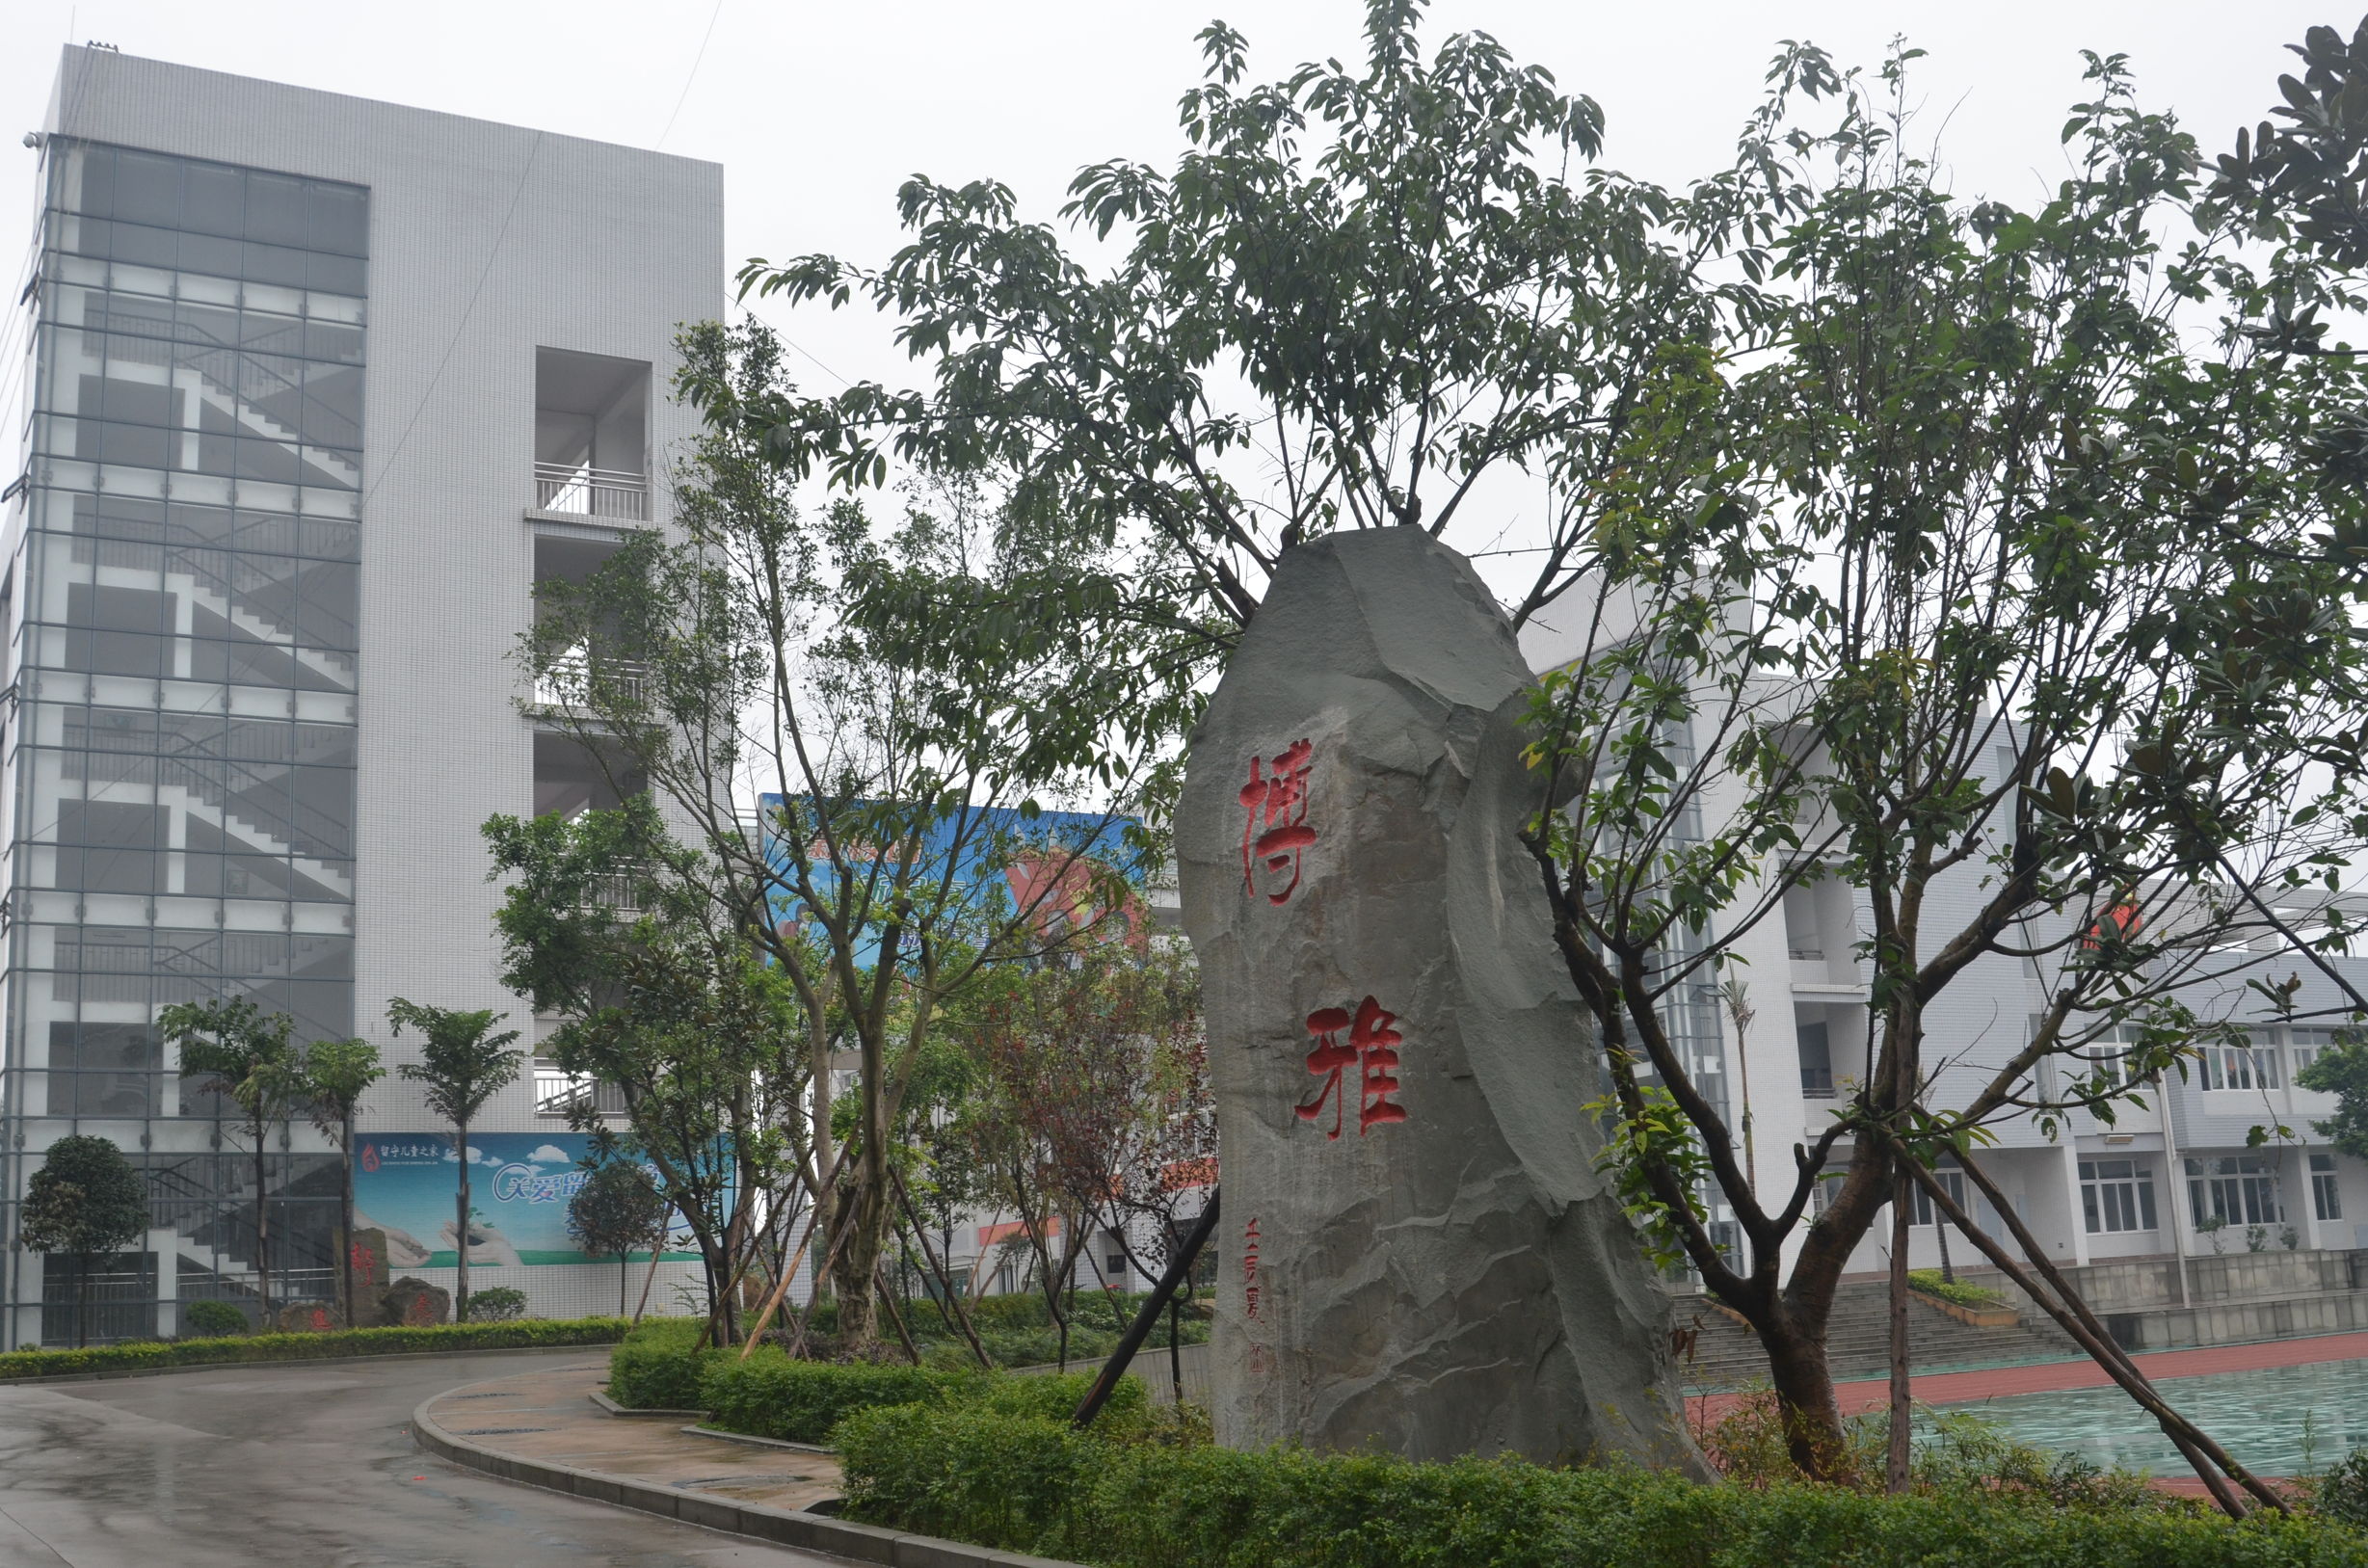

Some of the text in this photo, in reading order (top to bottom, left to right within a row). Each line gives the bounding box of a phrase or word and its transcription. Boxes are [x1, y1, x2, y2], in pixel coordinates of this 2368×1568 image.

[1238, 737, 1406, 1142] 博雅
[380, 1144, 439, 1157] 留守儿童之家
